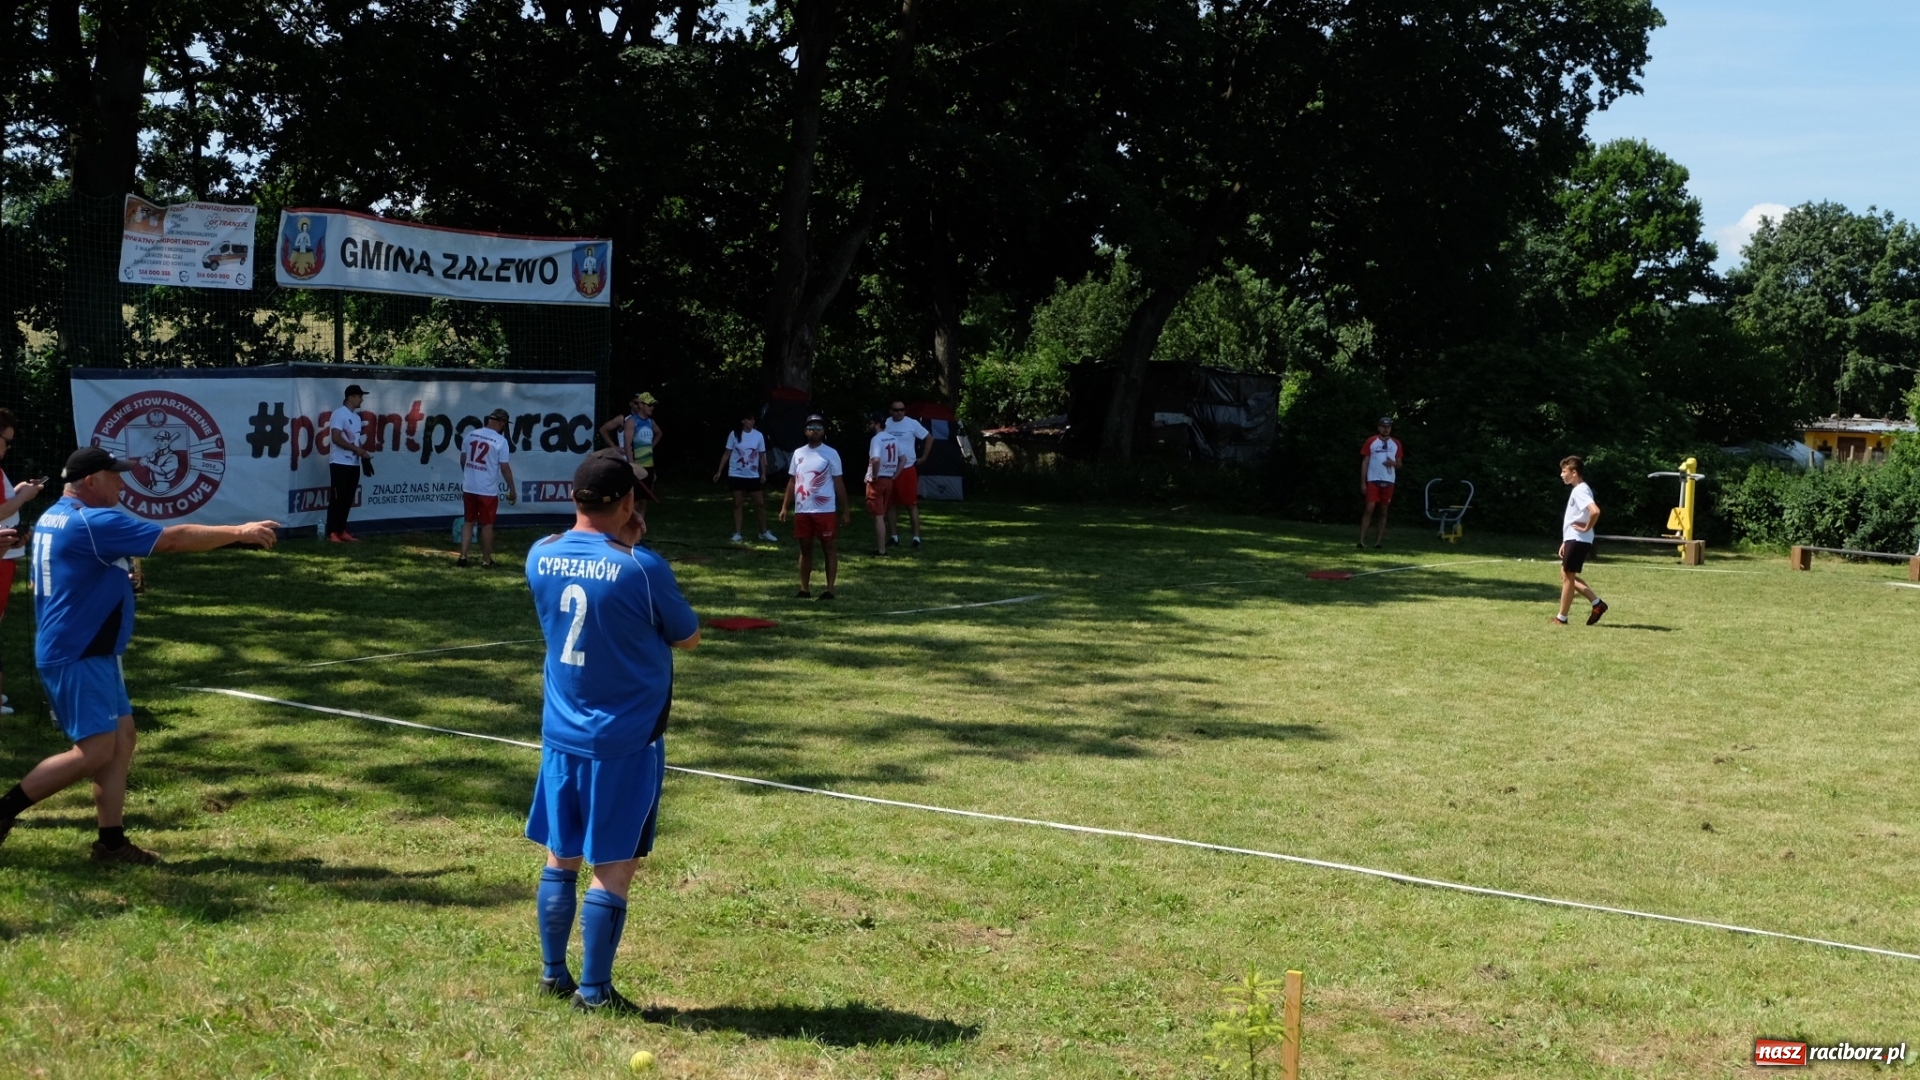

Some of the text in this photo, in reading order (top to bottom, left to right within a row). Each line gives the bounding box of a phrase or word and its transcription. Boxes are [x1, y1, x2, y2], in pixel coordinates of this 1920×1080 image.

[340, 236, 559, 285] GMINA ZALEWO
[102, 396, 213, 436] POLSKIE STOWARZYSZENIE
[201, 461, 216, 469] 2014
[469, 440, 490, 465] 12
[885, 443, 896, 462] 11
[119, 481, 212, 515] ALANTOWE
[368, 493, 465, 505] POLSKIE STOWARZYSZENI
[373, 482, 408, 495] ZNAJDŹ
[411, 482, 429, 493] NAS
[432, 482, 445, 493] NA
[33, 532, 52, 596] 11
[538, 556, 621, 582] CYPRZANÓW
[560, 584, 587, 667] 2
